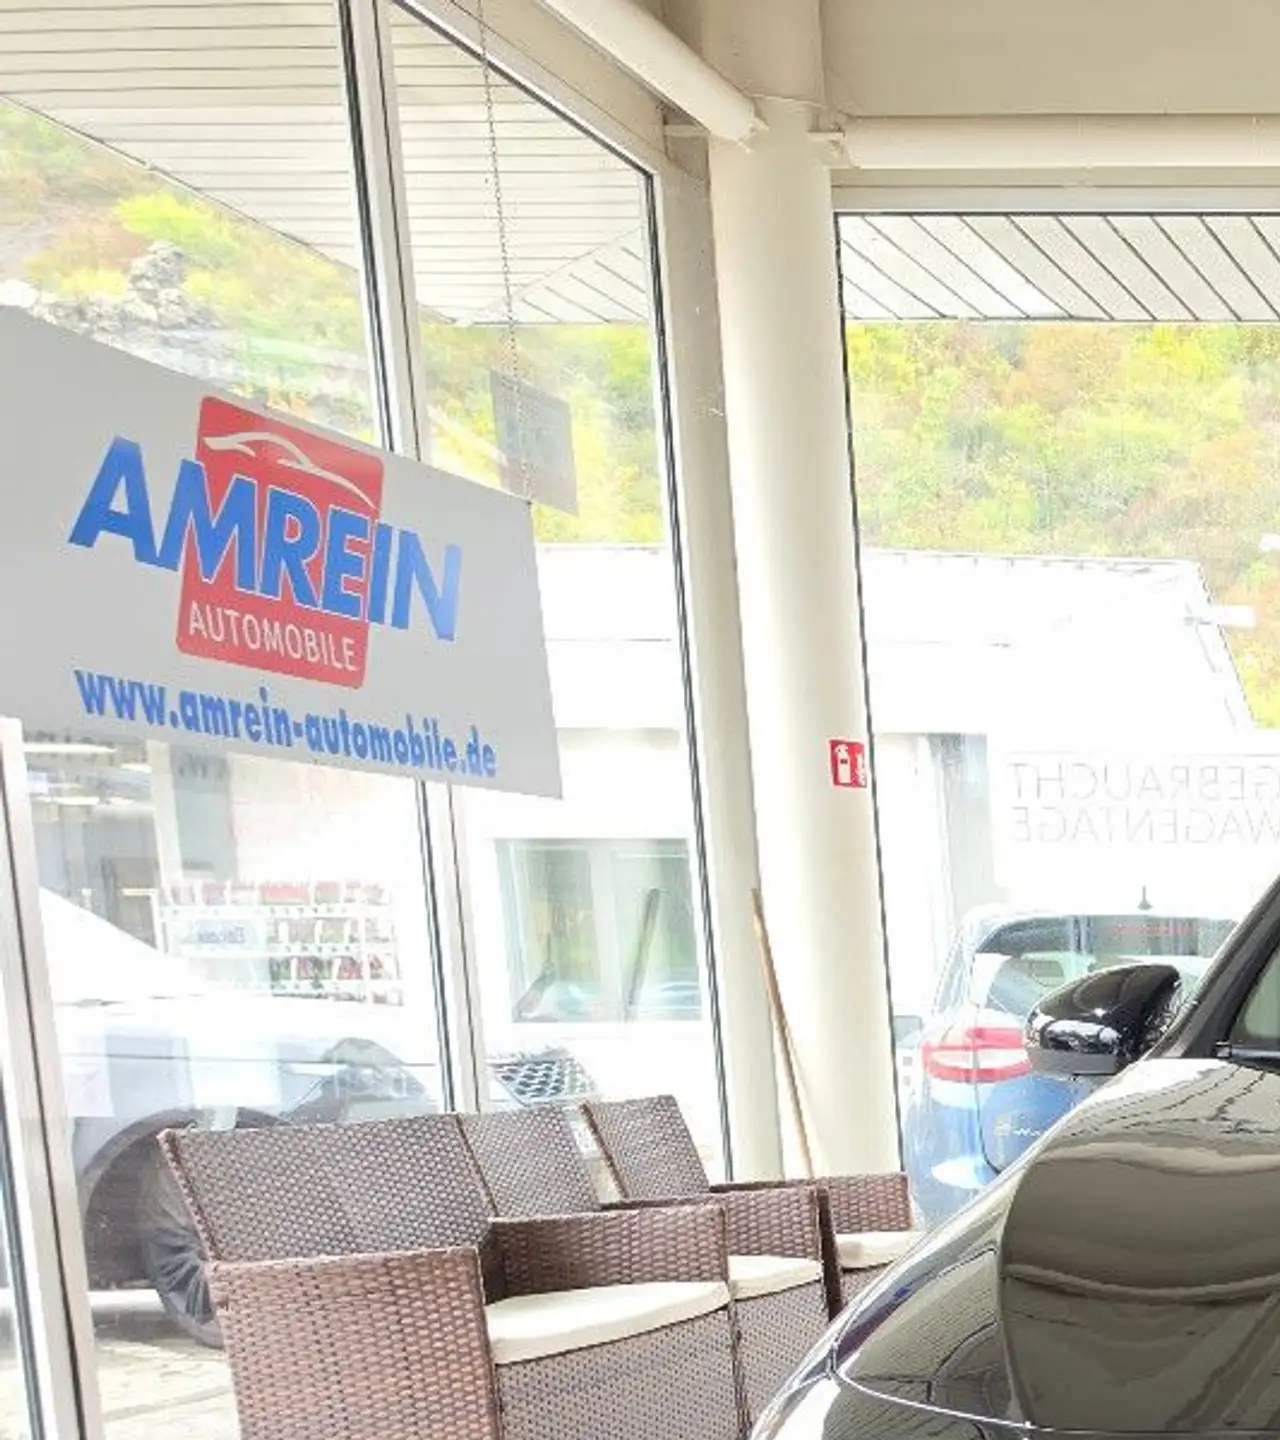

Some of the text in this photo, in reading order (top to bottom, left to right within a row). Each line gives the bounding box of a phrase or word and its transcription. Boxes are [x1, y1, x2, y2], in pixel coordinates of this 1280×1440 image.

[67, 437, 463, 642] AMREIN
[188, 601, 358, 673] AUTOMOBILE
[74, 669, 498, 777] www.amrein-automobile.de
